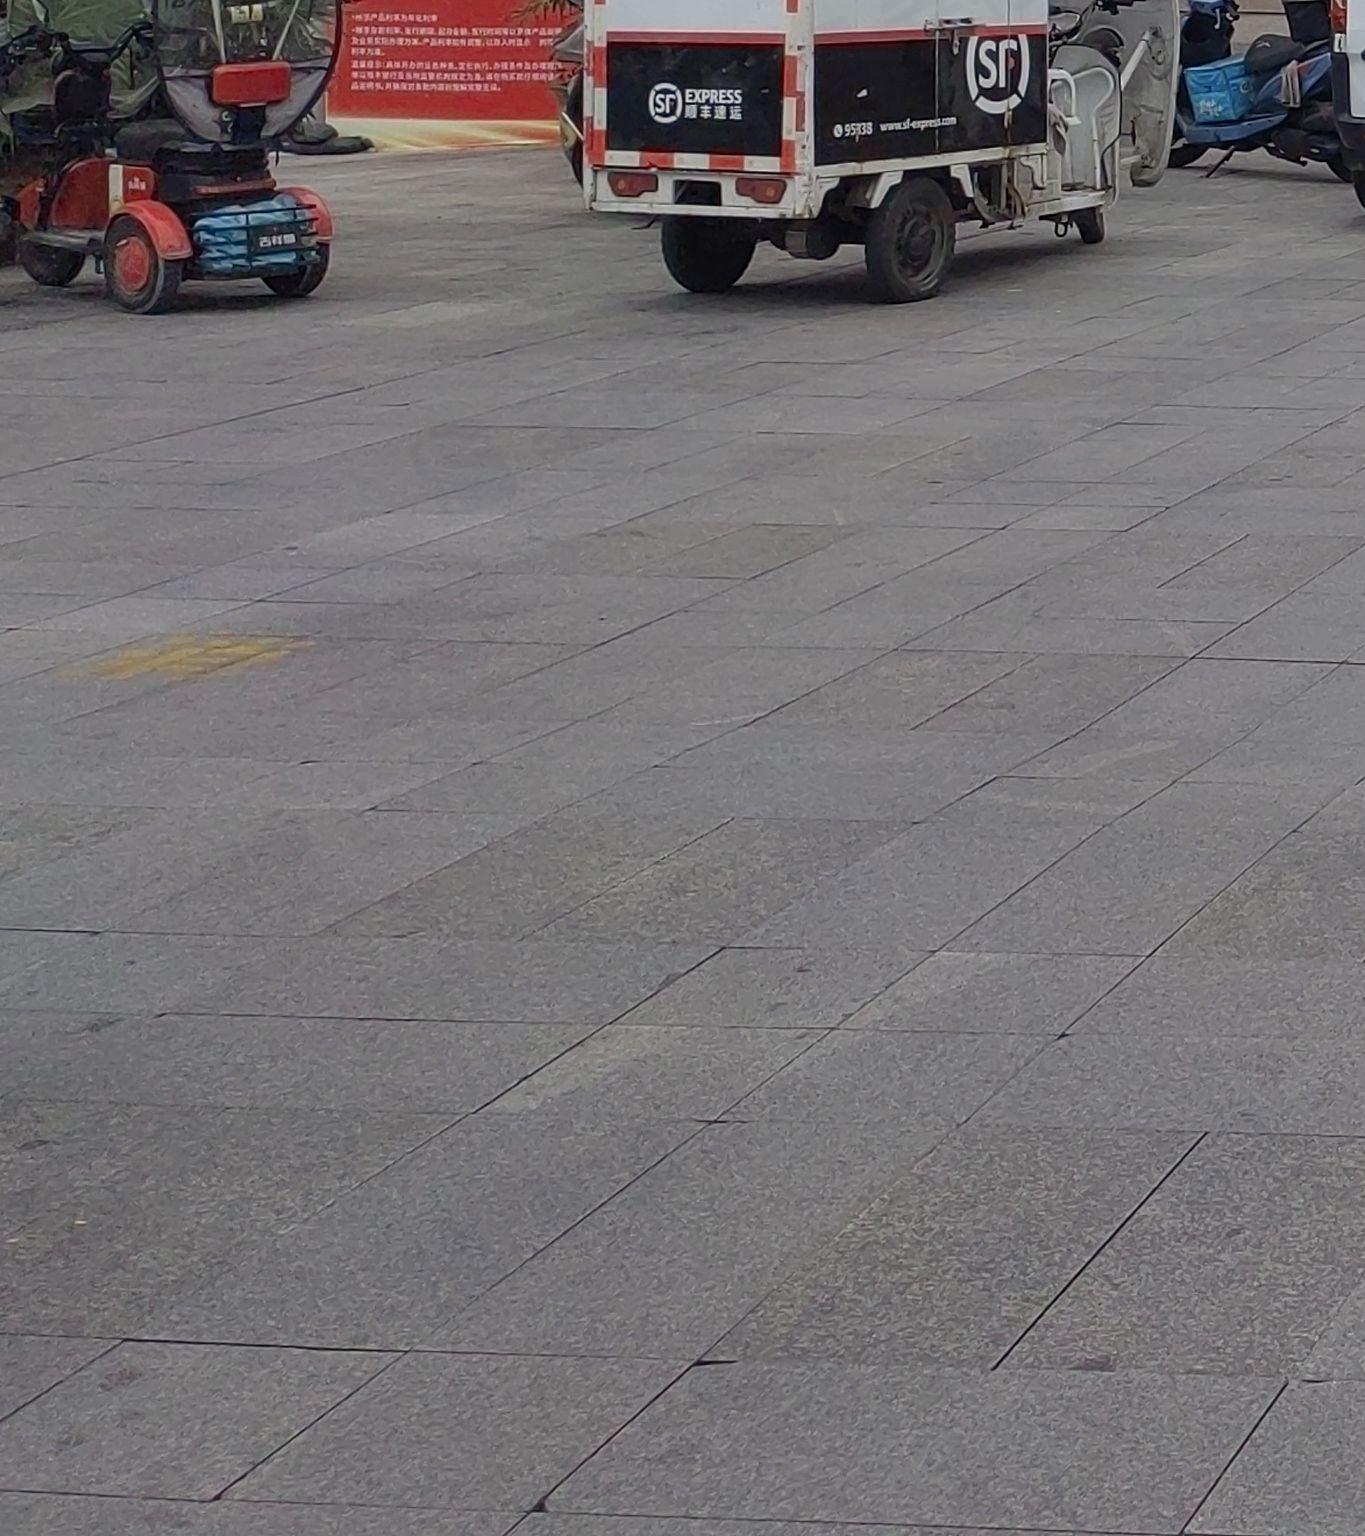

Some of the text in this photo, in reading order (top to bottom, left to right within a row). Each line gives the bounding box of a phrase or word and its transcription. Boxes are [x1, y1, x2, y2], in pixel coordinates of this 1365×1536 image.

[684, 88, 743, 104] EXPRESS
[684, 104, 743, 120] 顺丰速运
